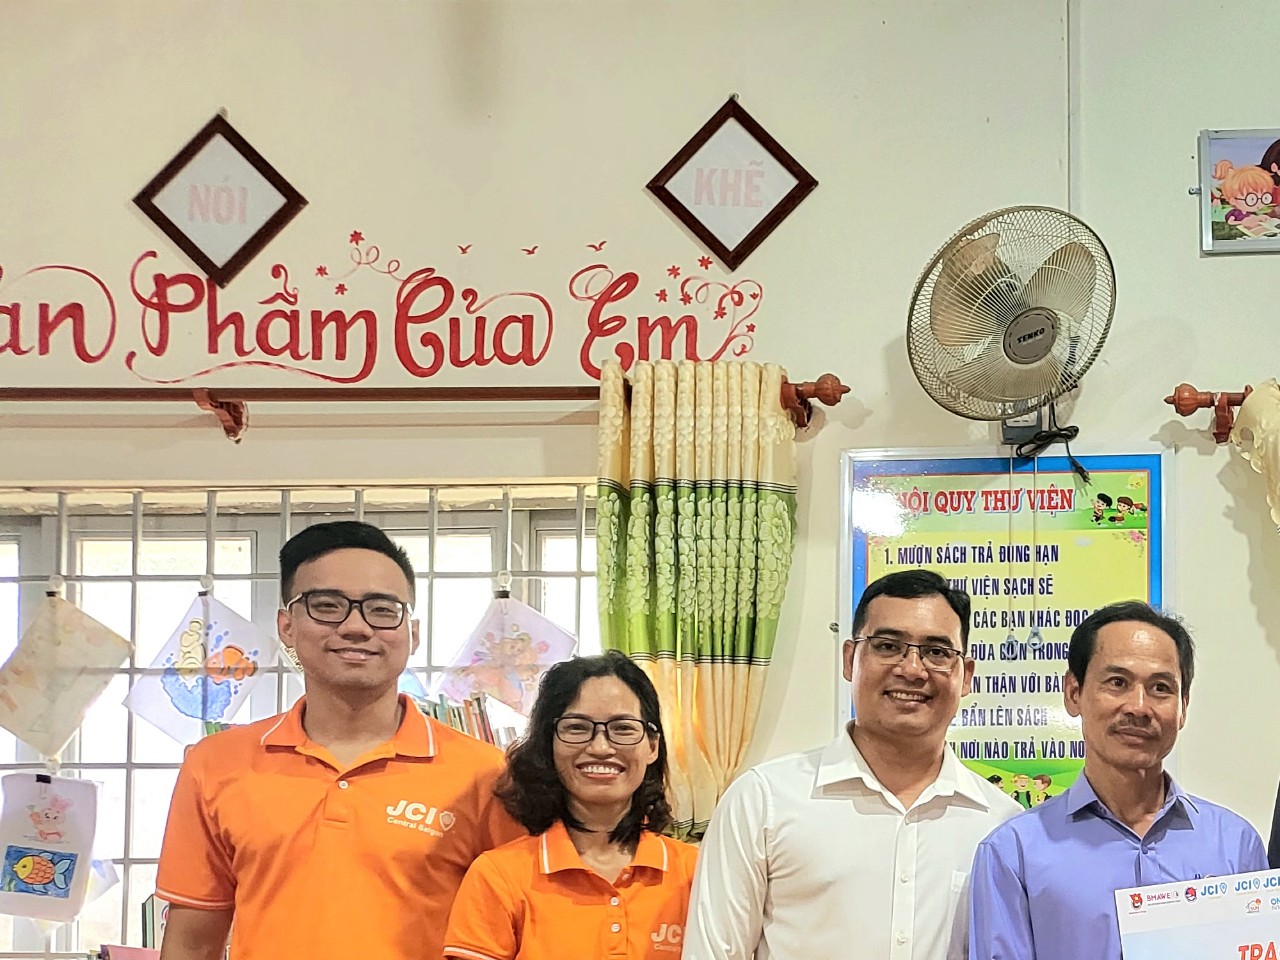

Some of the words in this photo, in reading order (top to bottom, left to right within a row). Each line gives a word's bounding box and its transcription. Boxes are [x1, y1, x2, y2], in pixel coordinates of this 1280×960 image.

[694, 158, 765, 209] KHẼ
[186, 175, 248, 225] NÓI
[125, 250, 378, 384] Phẩm
[395, 268, 553, 378] Của
[569, 264, 735, 380] Em
[1016, 327, 1045, 344] SENKO
[934, 489, 977, 515] QUY
[980, 487, 1024, 513] THƯ
[1026, 484, 1075, 517] VIỆN
[884, 547, 894, 565] 1.
[897, 545, 932, 568] MƯỢN
[936, 543, 967, 564] SÁCH
[971, 541, 994, 563] TRẢ
[1034, 545, 1059, 566] HẠN
[971, 574, 999, 600] VIỆN
[1003, 577, 1034, 599] SẠCH
[1038, 574, 1053, 595] SẼ
[973, 607, 997, 629] CÁC
[1001, 610, 1025, 632] BẠN
[971, 640, 995, 661] ĐÙA
[985, 674, 1017, 698] THẬN
[1020, 672, 1041, 694] VỚI
[961, 703, 986, 727] BẨN
[990, 705, 1013, 727] LÊN
[960, 738, 980, 759] NƠI
[984, 737, 1009, 759] NÀO
[1013, 736, 1036, 759] TRẢ
[1041, 737, 1065, 759] VÀO
[386, 799, 438, 825] JCI
[386, 816, 417, 829] Central
[418, 824, 444, 838] Saigon
[1200, 885, 1218, 897] JCI
[1235, 880, 1252, 892] JCI
[1263, 876, 1280, 889] JCI
